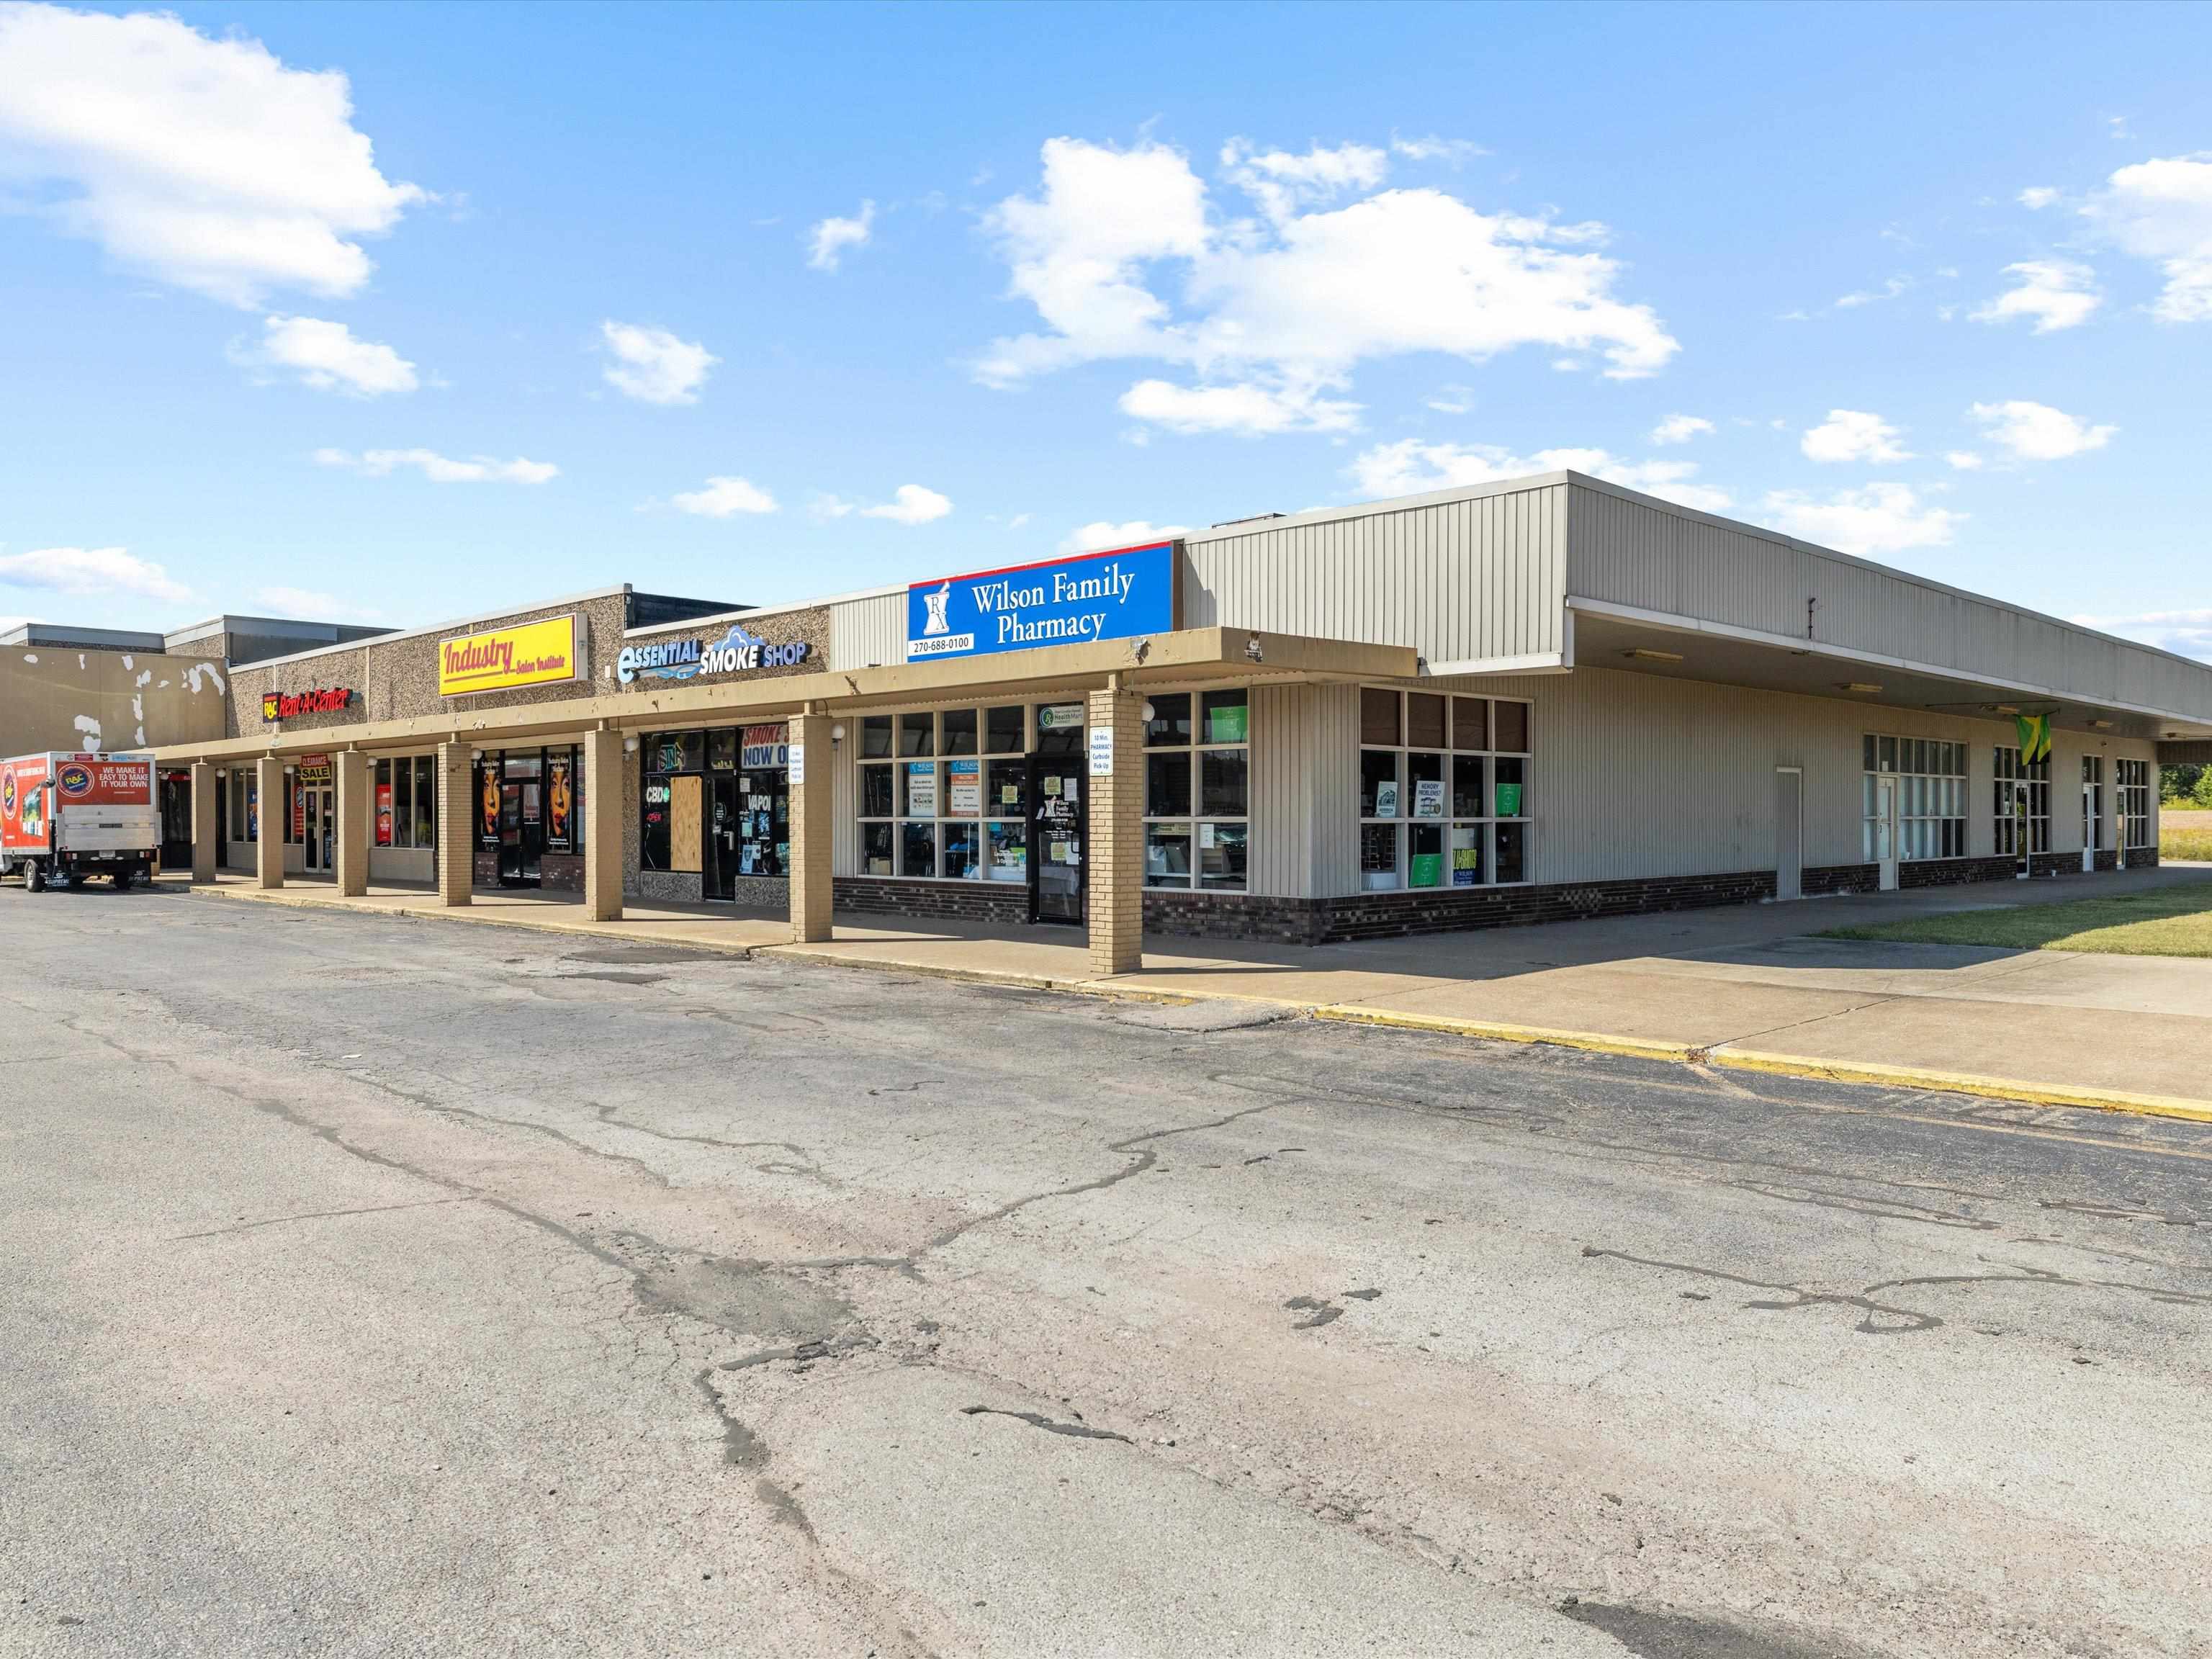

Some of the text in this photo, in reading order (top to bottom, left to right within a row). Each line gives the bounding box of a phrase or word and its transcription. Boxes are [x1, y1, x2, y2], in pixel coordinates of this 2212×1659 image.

[971, 562, 1135, 614] Wilson Family
[997, 613, 1107, 644] Pharmacy
[914, 637, 969, 653] 270-688-0100
[444, 638, 513, 675] Industry
[516, 655, 565, 675] Salon Institute
[699, 645, 759, 675] SMOKE
[764, 642, 806, 668] SHOP
[264, 701, 277, 719] RAC
[279, 688, 349, 717] Rent-A-Center
[744, 725, 781, 747] SMOKE
[743, 746, 773, 766] NOW
[302, 768, 329, 779] SALE
[646, 786, 664, 803] CBD
